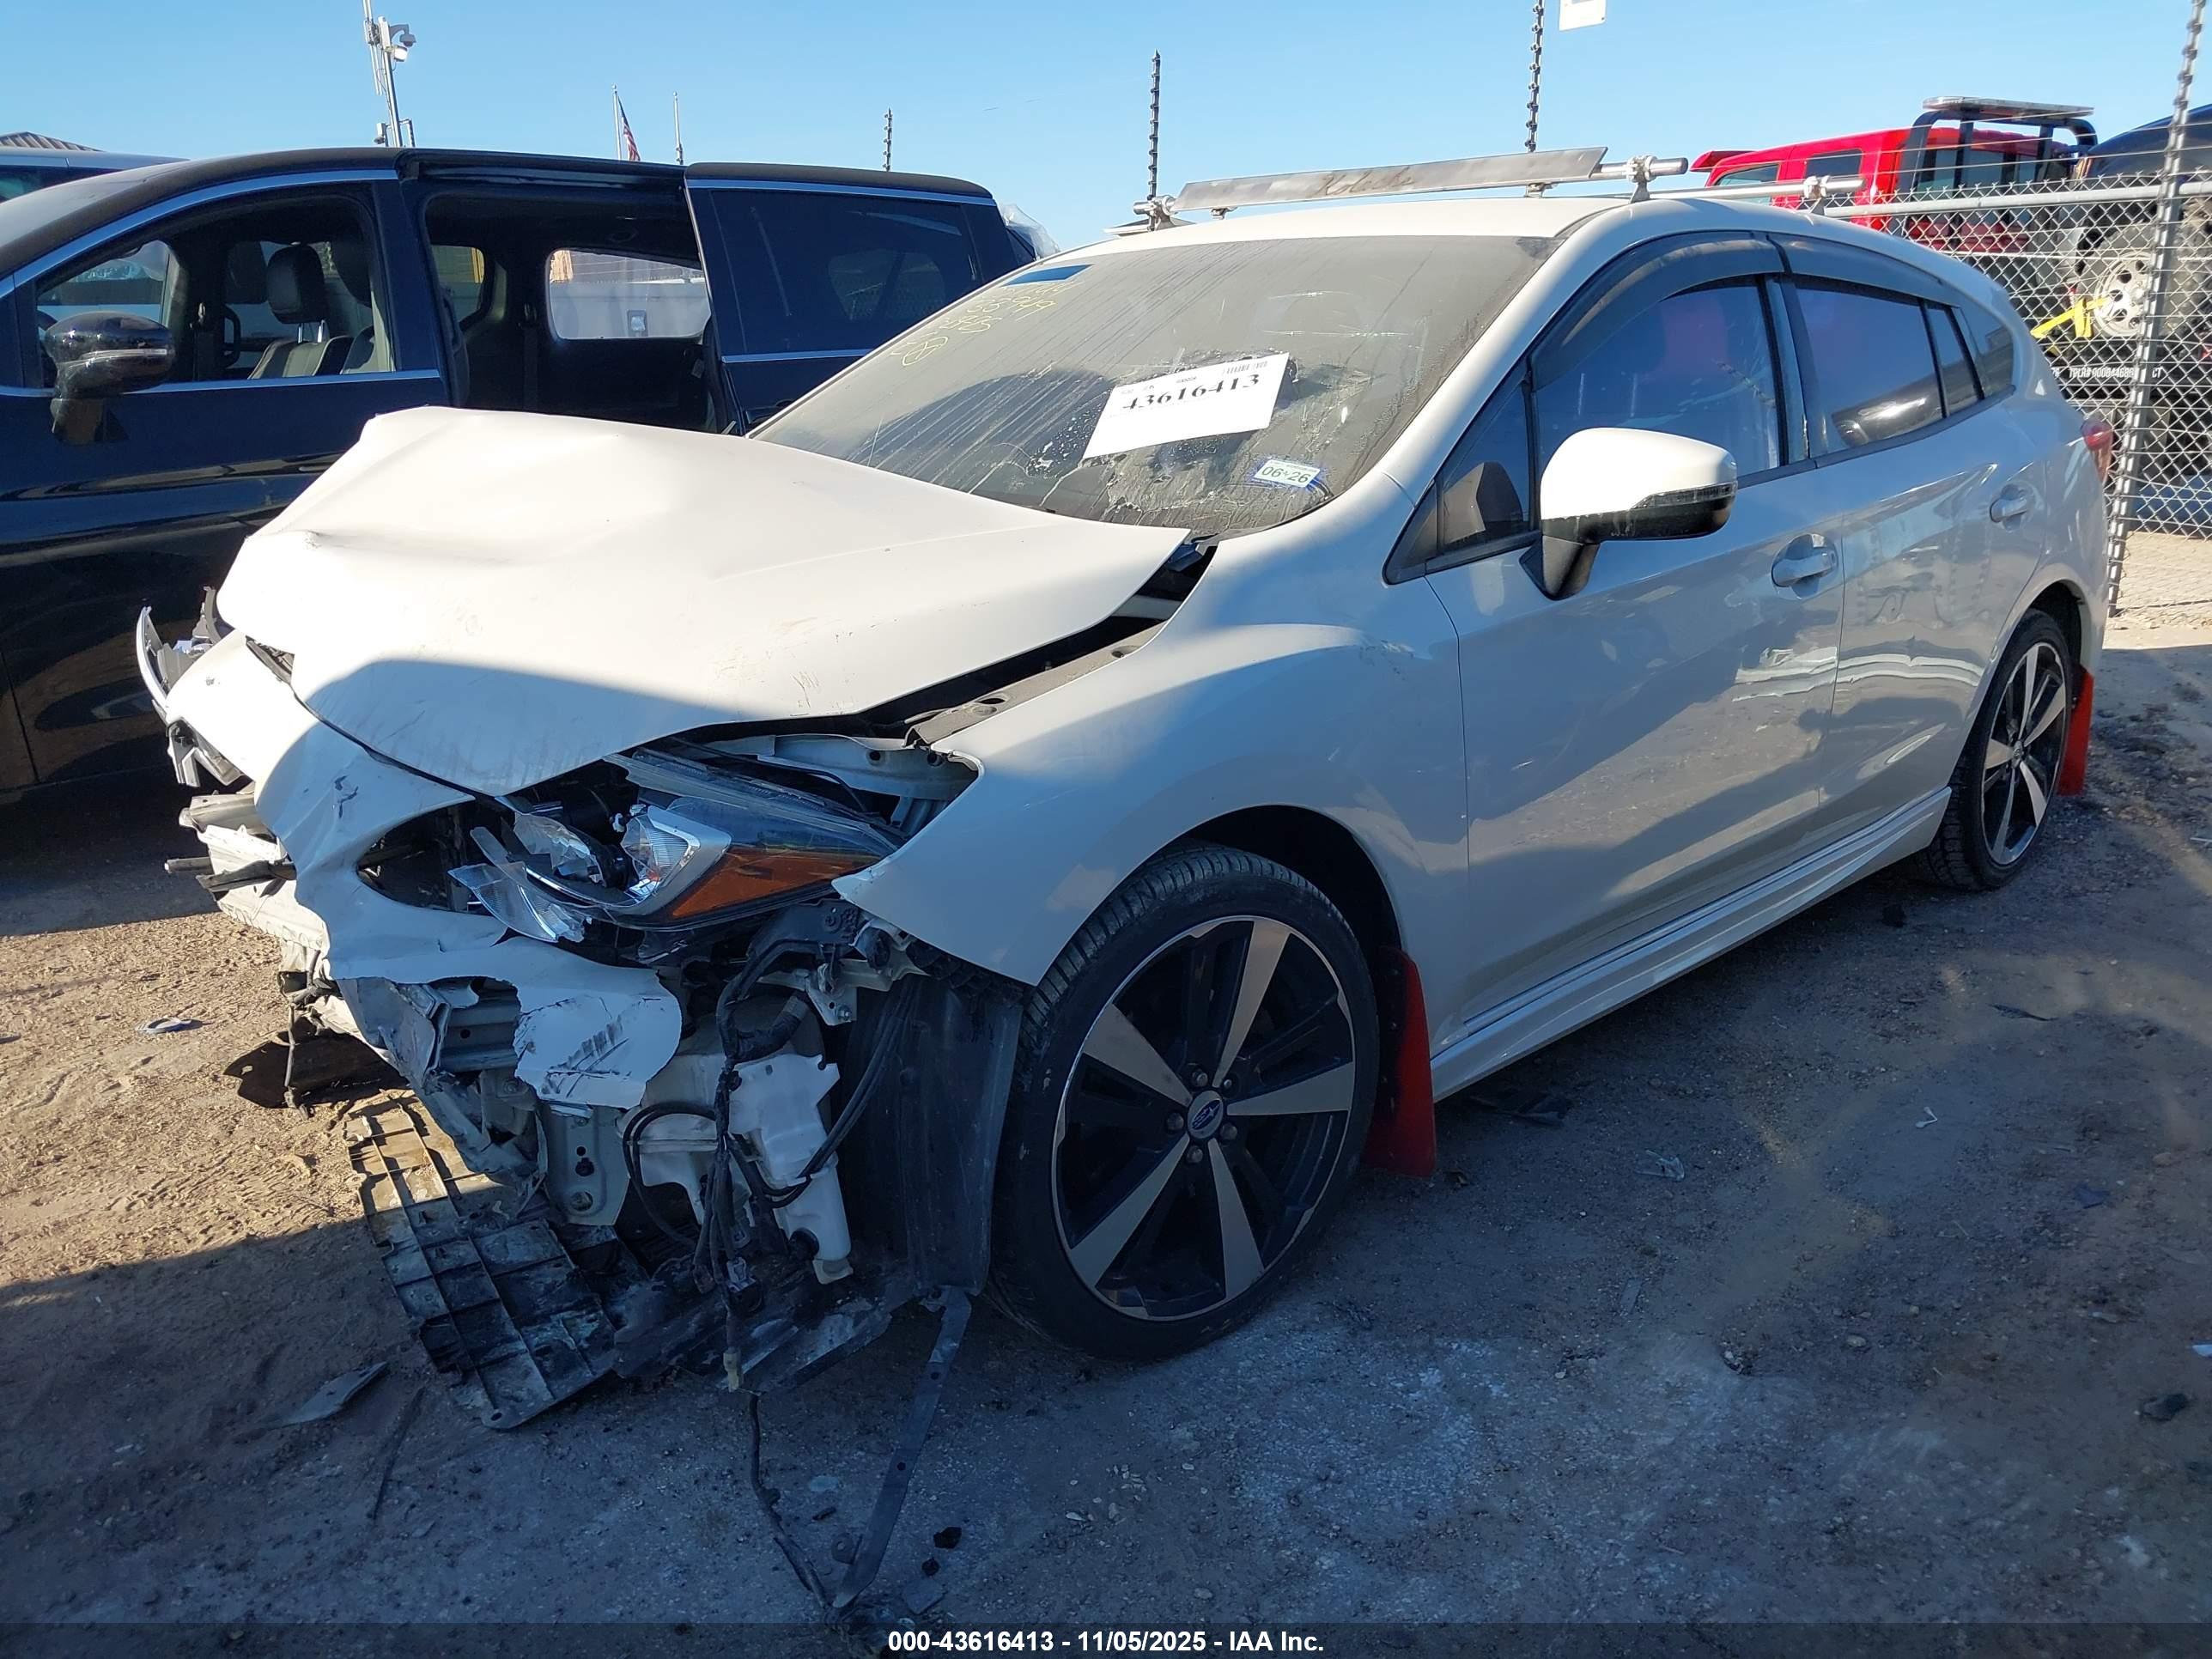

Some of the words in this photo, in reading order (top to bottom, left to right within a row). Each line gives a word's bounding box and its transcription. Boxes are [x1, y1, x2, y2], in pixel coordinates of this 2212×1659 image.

[1122, 374, 1260, 410] 43616413
[1261, 466, 1284, 477] 06
[1287, 471, 1311, 483] 26
